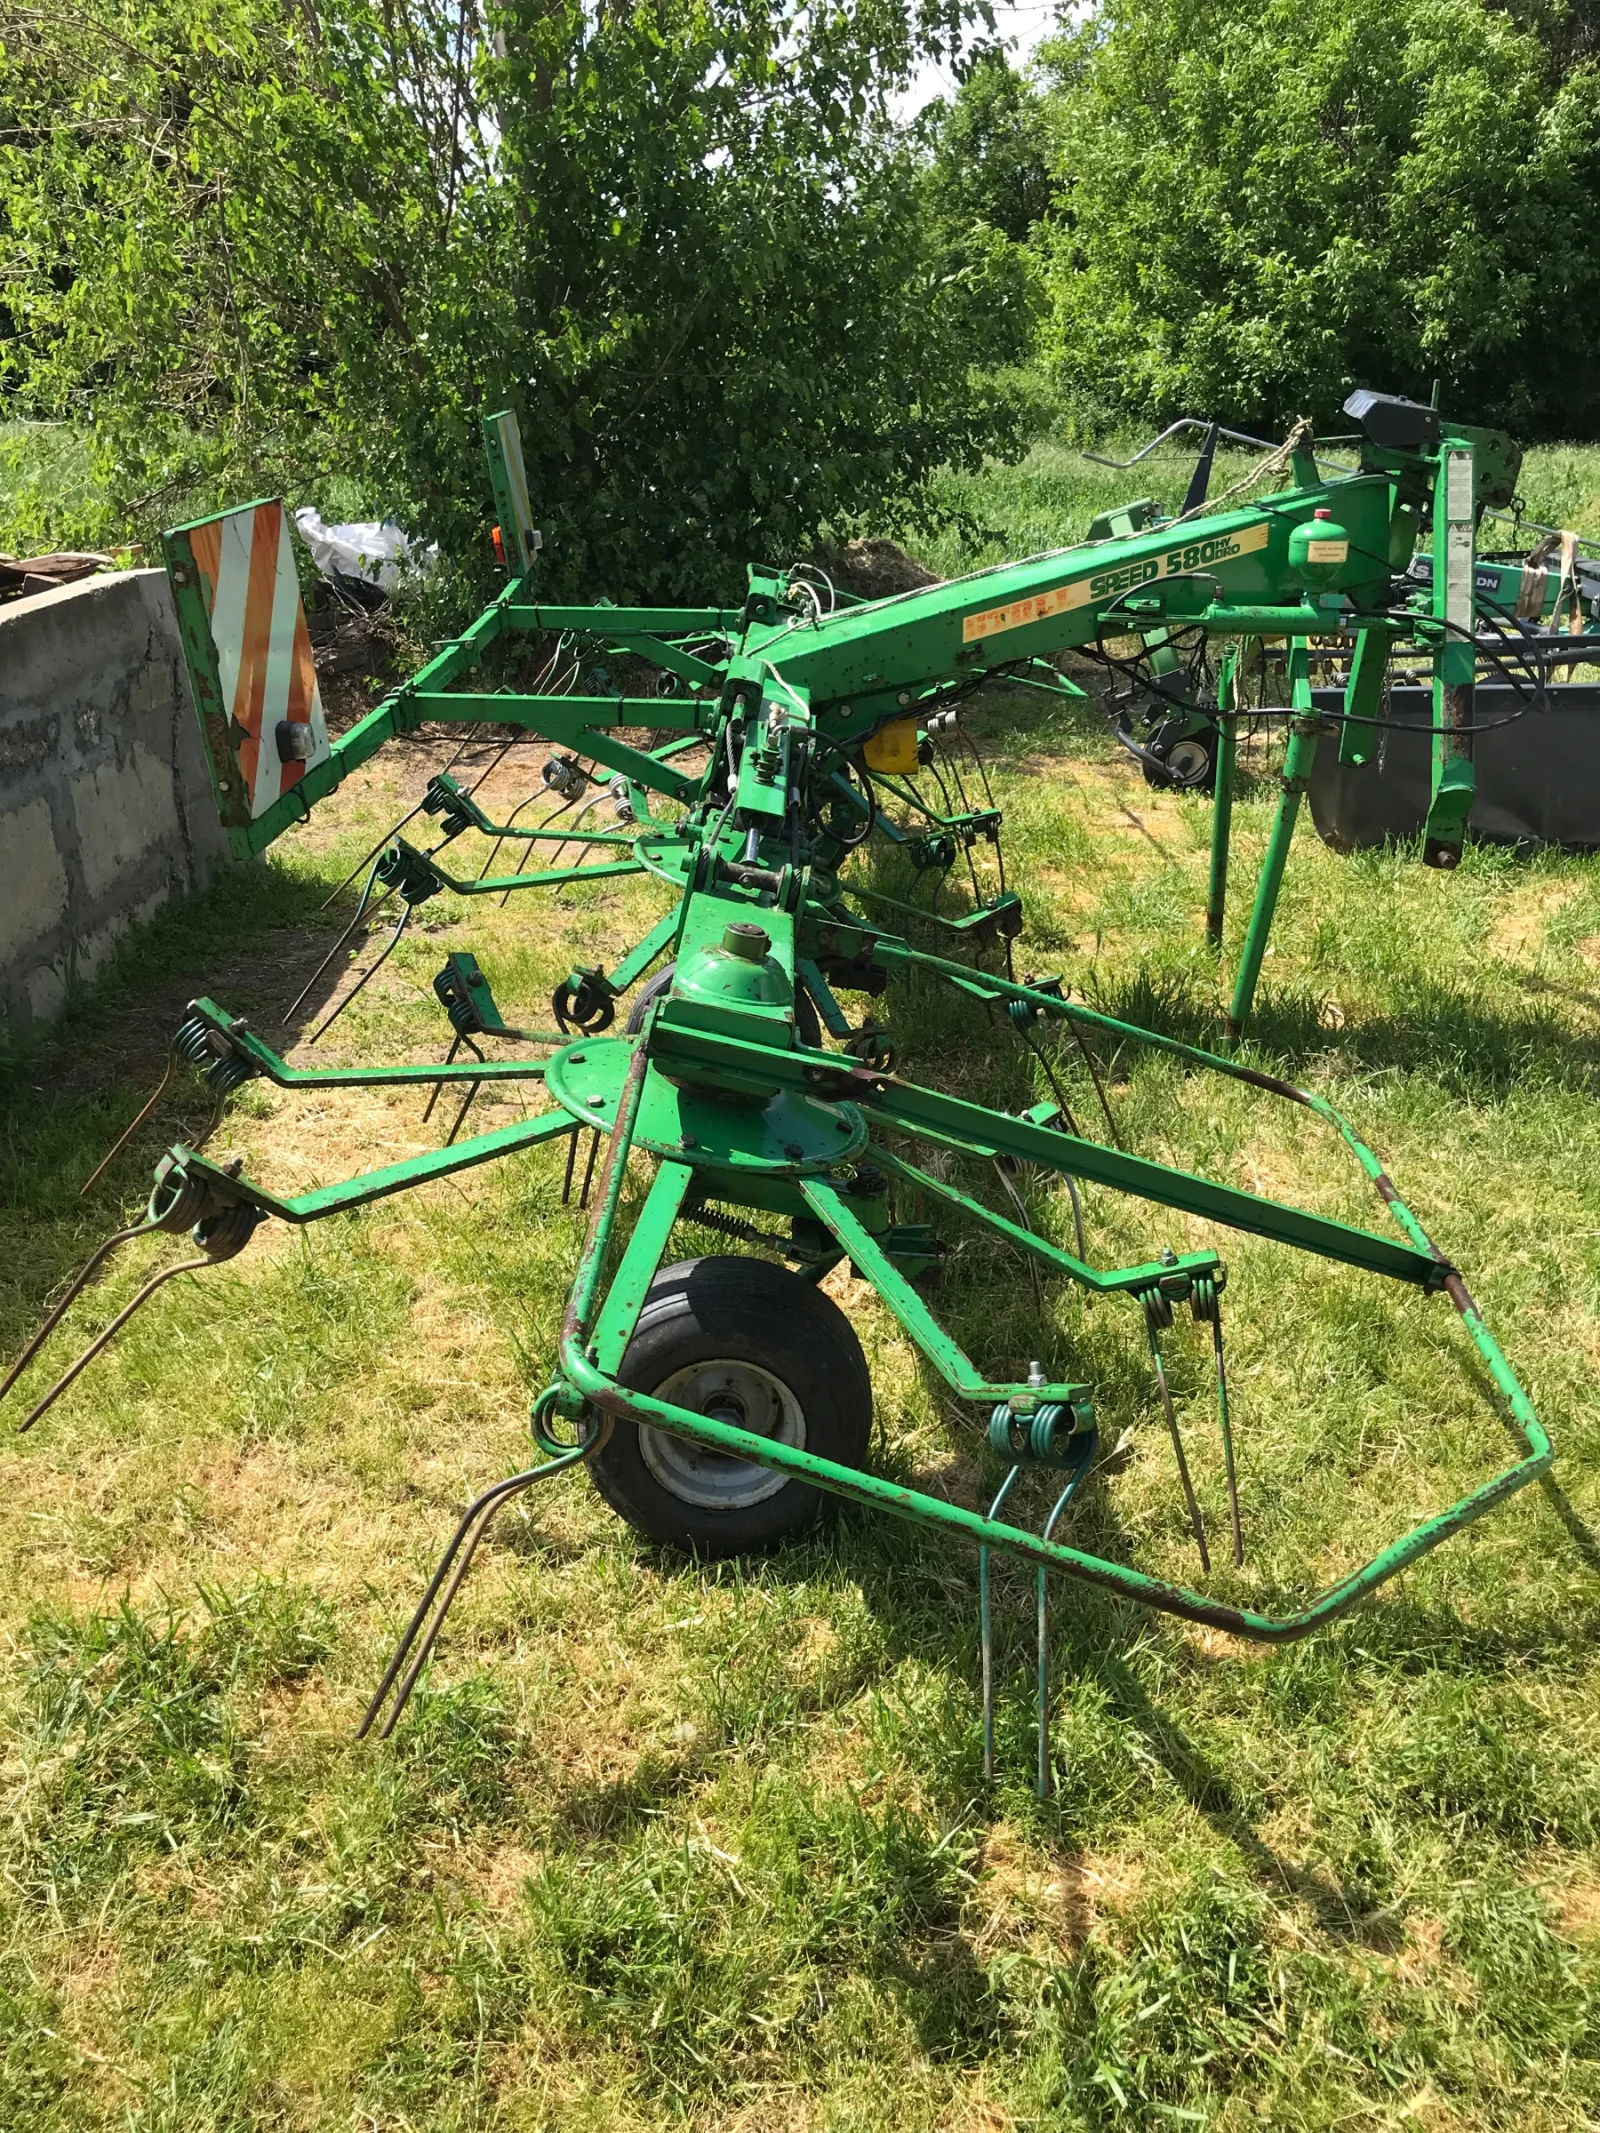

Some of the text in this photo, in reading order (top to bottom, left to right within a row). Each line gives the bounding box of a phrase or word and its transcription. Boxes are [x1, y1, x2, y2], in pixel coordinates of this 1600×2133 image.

[1215, 537, 1232, 549] HY
[1215, 543, 1241, 560] DRO
[1090, 560, 1158, 599] SPEED
[1166, 541, 1215, 575] 580
